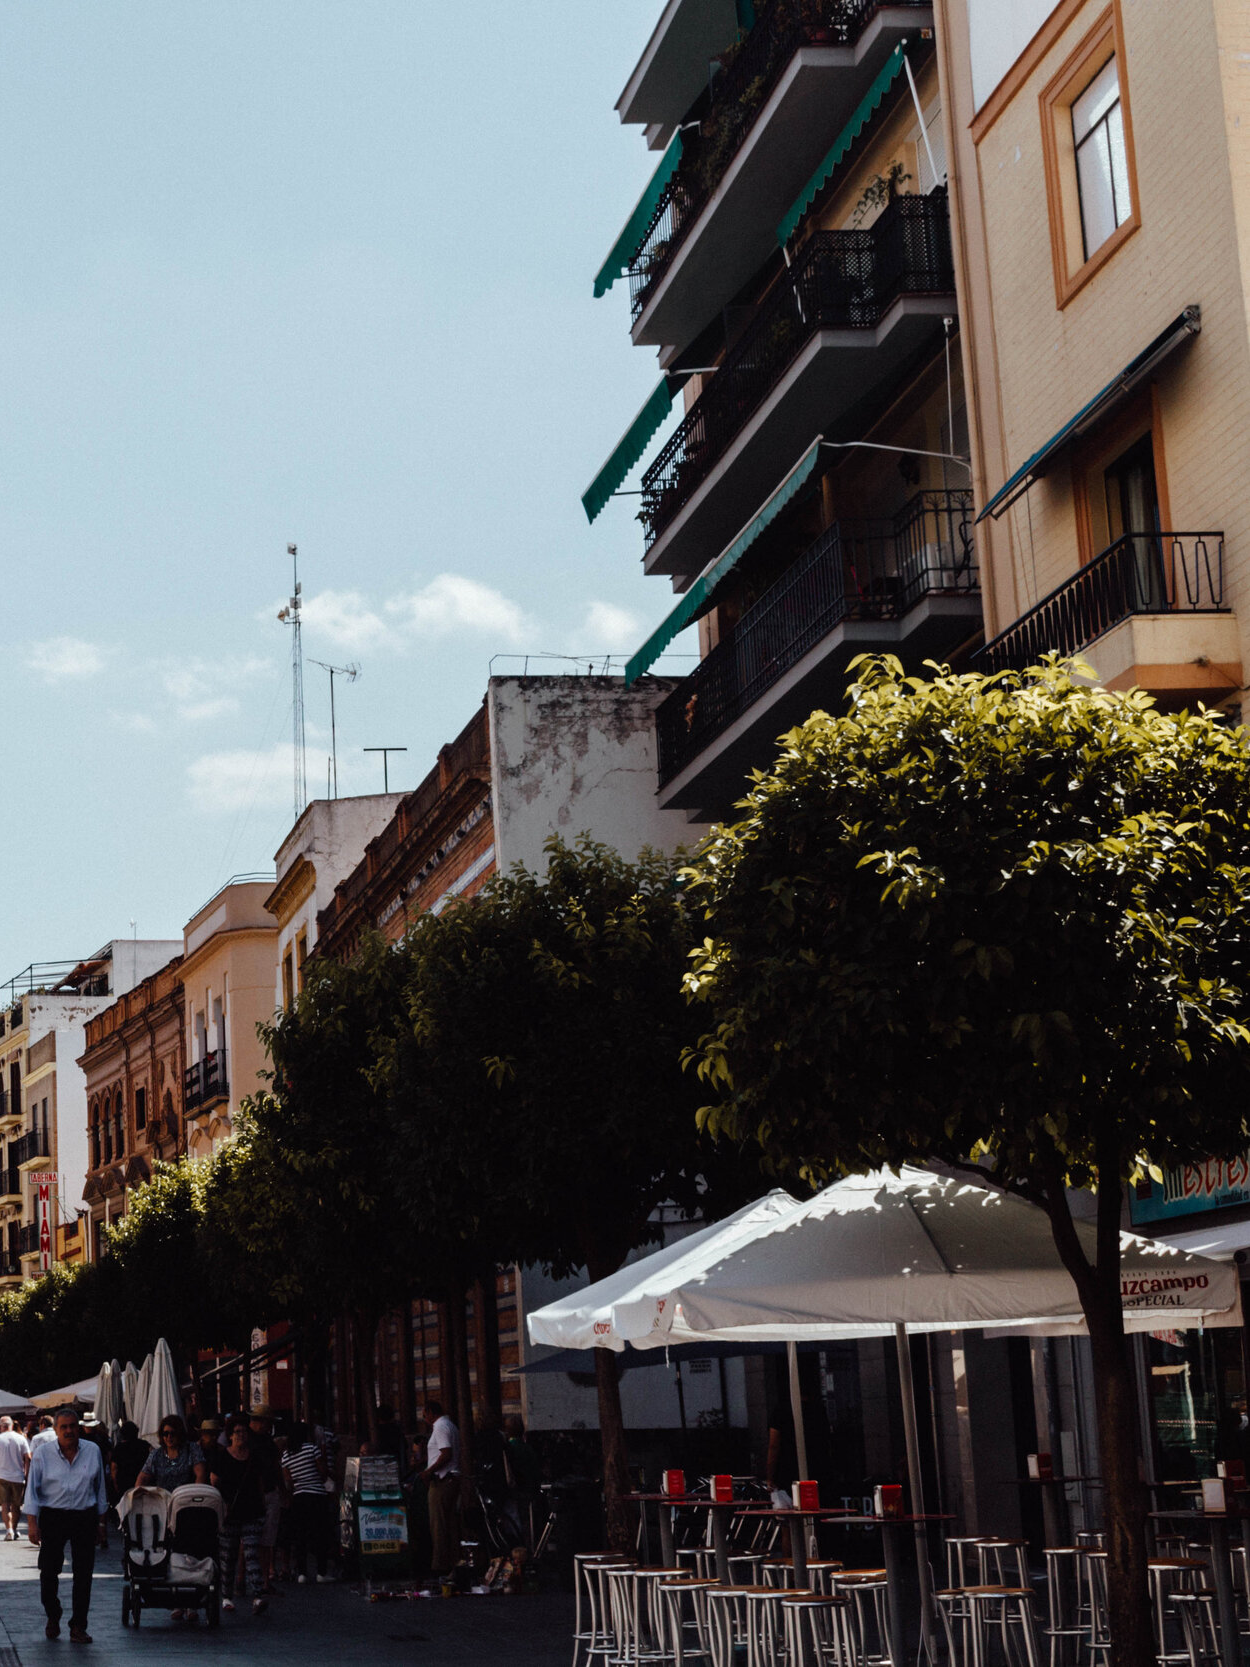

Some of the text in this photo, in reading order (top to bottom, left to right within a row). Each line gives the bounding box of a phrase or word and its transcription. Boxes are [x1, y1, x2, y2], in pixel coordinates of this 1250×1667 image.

[30, 1173, 57, 1183] TABERNA
[39, 1184, 50, 1270] MIAMI
[1120, 1274, 1209, 1296] uzcampo
